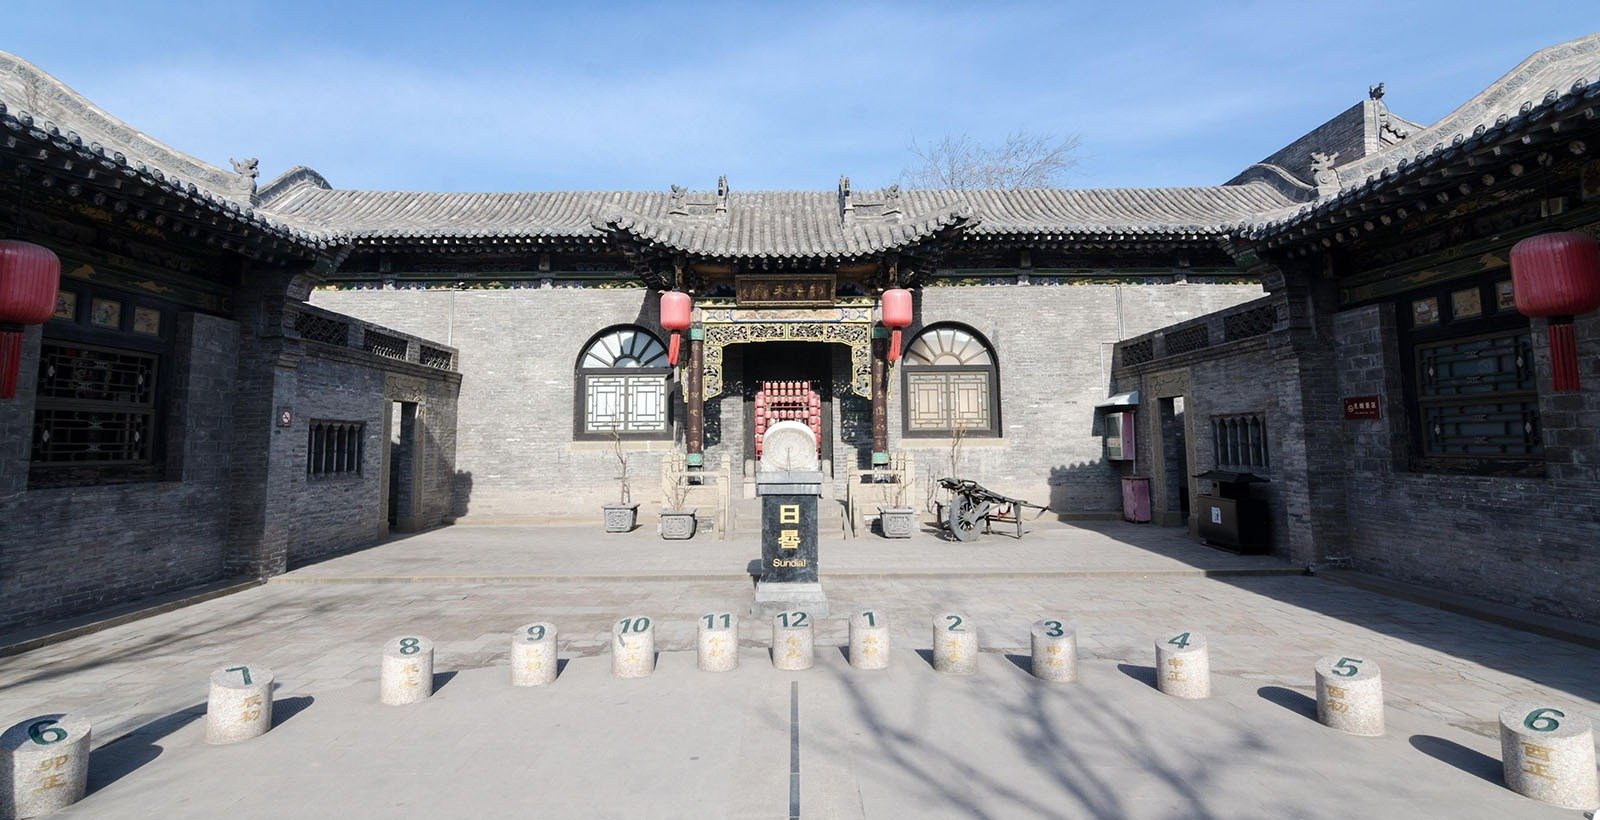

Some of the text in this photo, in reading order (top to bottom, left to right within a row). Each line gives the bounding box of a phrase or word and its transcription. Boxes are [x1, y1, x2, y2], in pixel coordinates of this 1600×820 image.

[778, 505, 801, 549] 日晷
[773, 559, 806, 568] Sundial
[619, 617, 651, 633] 10
[702, 613, 731, 628] 11
[777, 612, 809, 627] 12
[863, 612, 876, 627] 1
[946, 615, 965, 631] 2
[1045, 620, 1065, 637] 3
[526, 625, 546, 641] 9
[1168, 632, 1190, 649] 4
[399, 637, 420, 655] 8
[225, 665, 252, 685] 7
[1167, 657, 1187, 682] 申正
[1331, 656, 1363, 677] 5
[1326, 685, 1349, 715] 酉初
[1523, 708, 1566, 732] 6
[28, 719, 68, 745] 6
[1523, 742, 1556, 780] 酉正
[32, 755, 69, 793] 卯正
